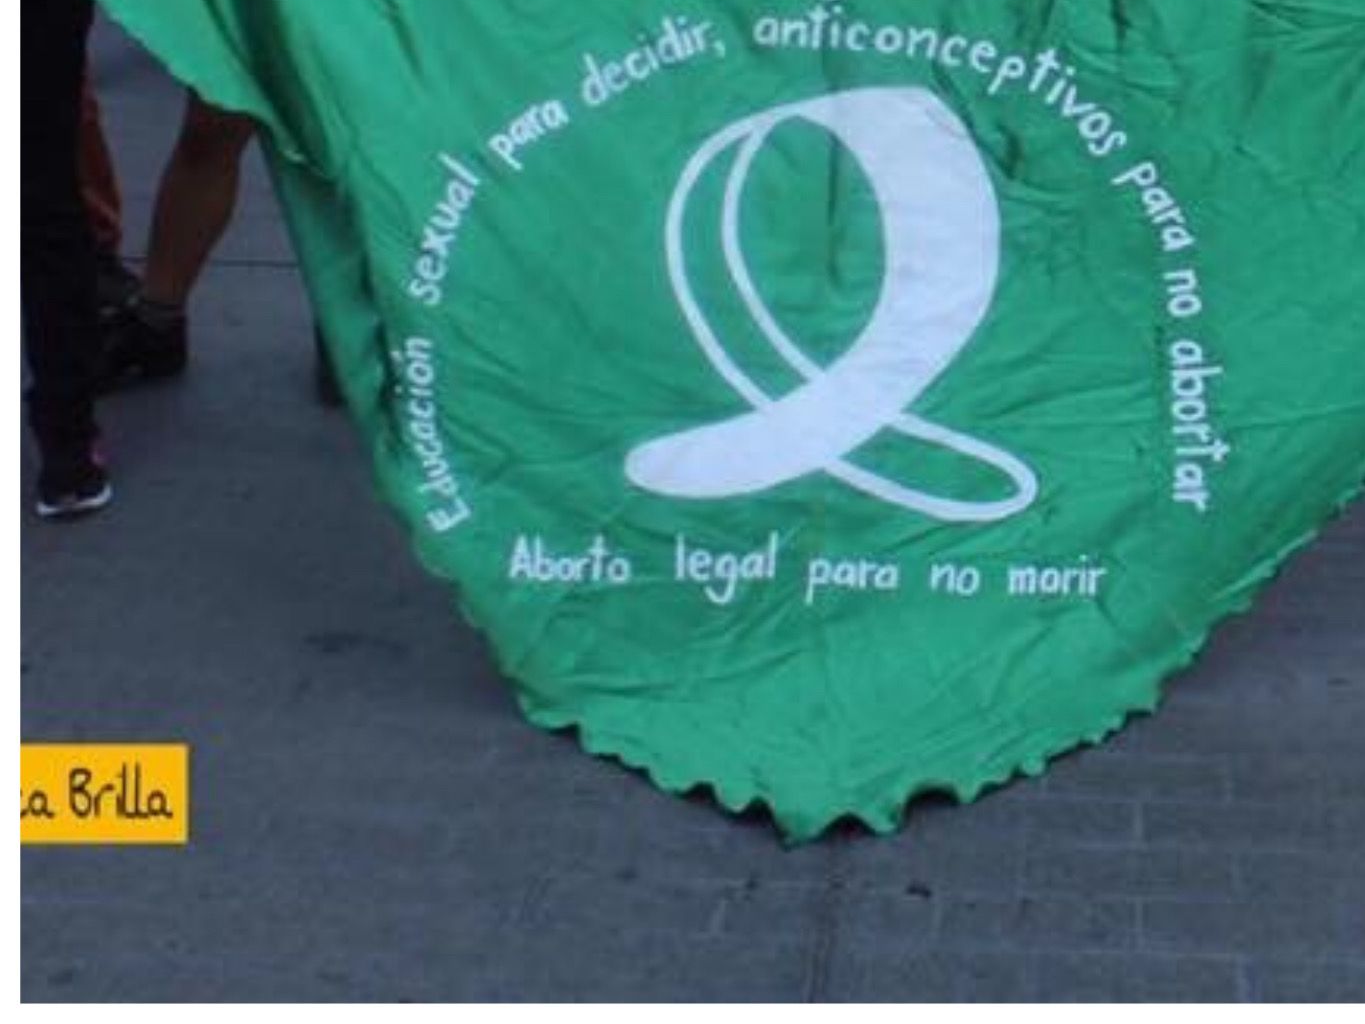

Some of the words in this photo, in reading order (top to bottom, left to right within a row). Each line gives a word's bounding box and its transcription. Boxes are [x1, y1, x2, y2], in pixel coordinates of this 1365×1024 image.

[753, 9, 1127, 159] anticonceptivos
[487, 98, 571, 170] para
[406, 153, 483, 307] sexual
[1112, 160, 1196, 254] para
[1162, 268, 1204, 320] no
[1167, 339, 1232, 514] abortar
[509, 533, 632, 584] Aborto
[675, 530, 778, 605] legal
[806, 558, 899, 605] para
[929, 564, 981, 598] no
[1007, 556, 1105, 599] morir
